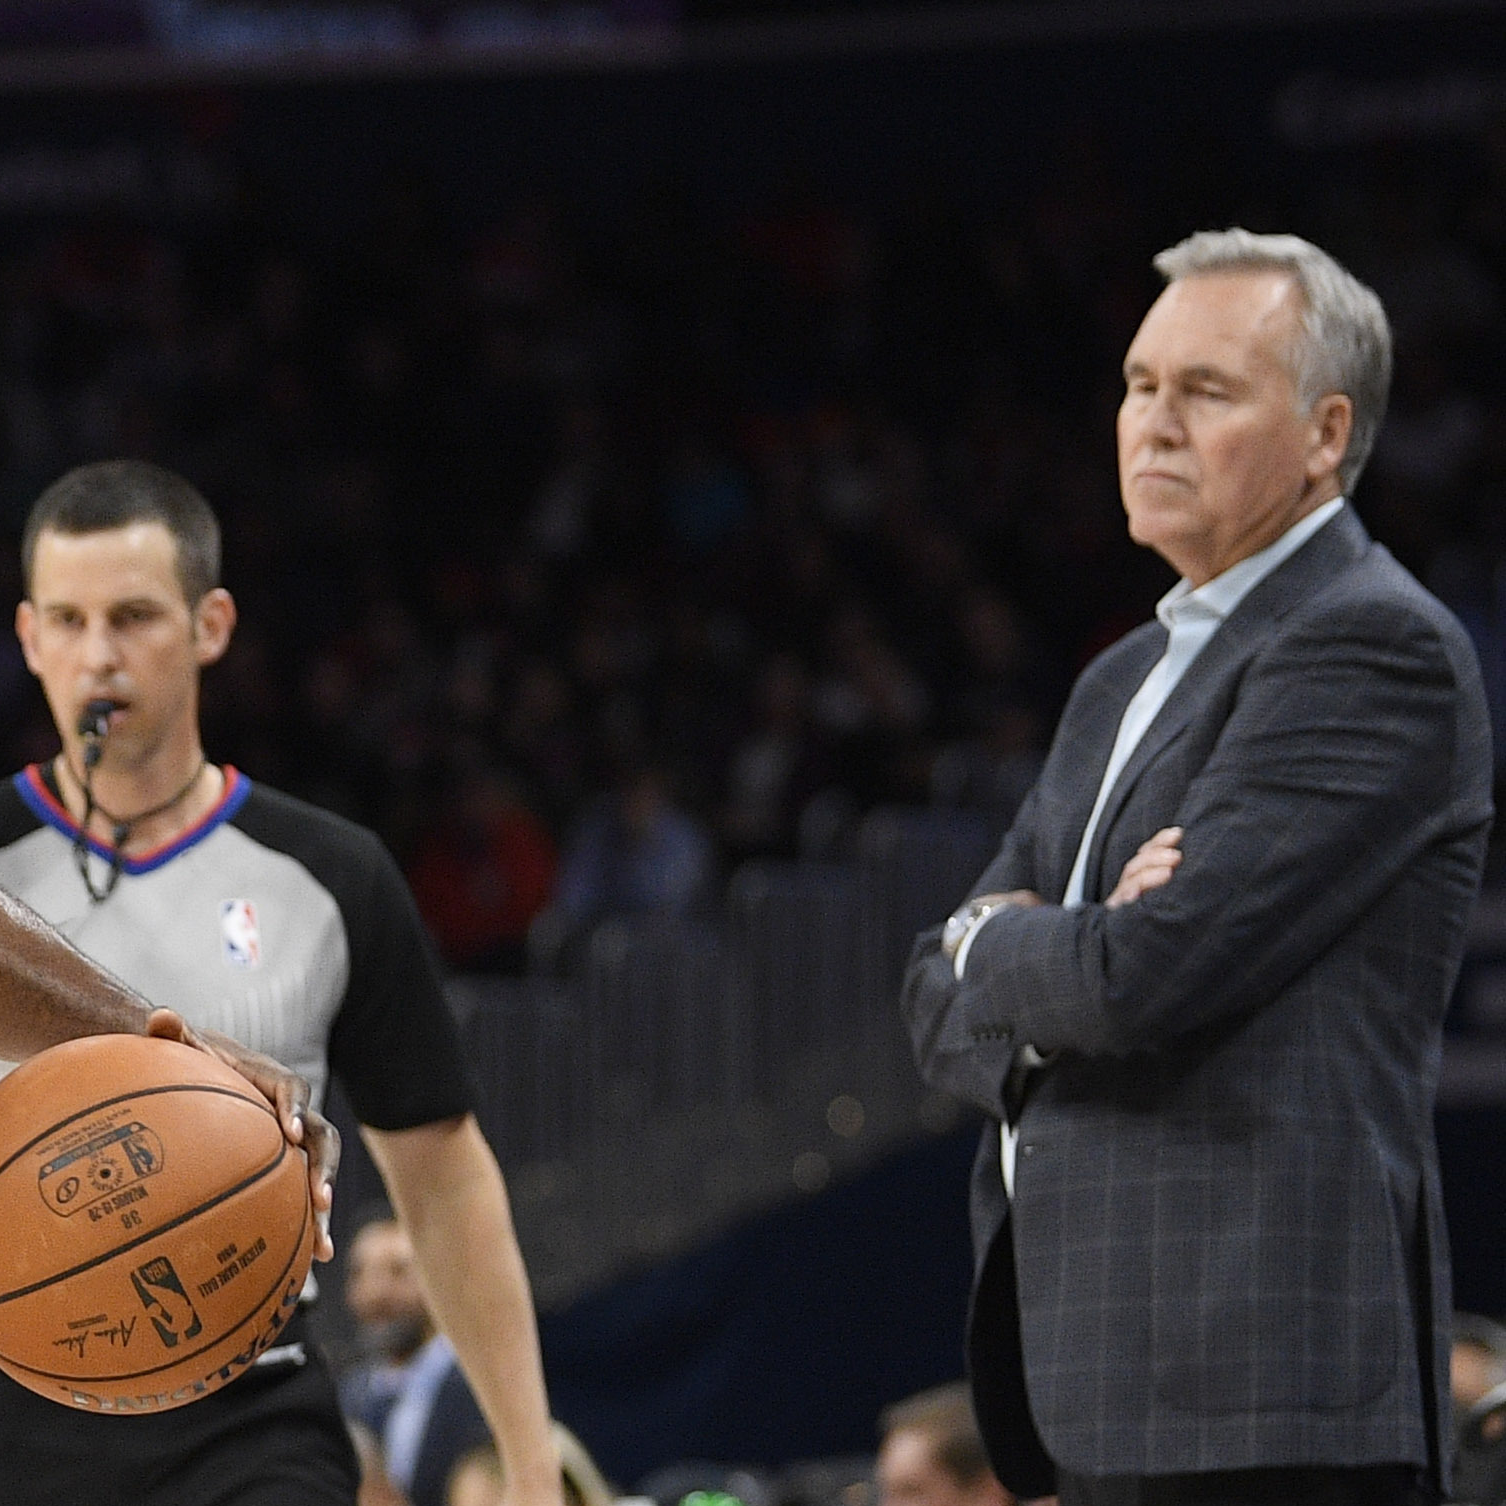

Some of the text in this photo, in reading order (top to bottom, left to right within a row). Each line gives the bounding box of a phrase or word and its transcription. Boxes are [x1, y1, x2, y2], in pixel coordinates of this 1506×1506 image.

[145, 1259, 171, 1282] NBA
[216, 1262, 240, 1288] GAME
[196, 1277, 220, 1299] BALL
